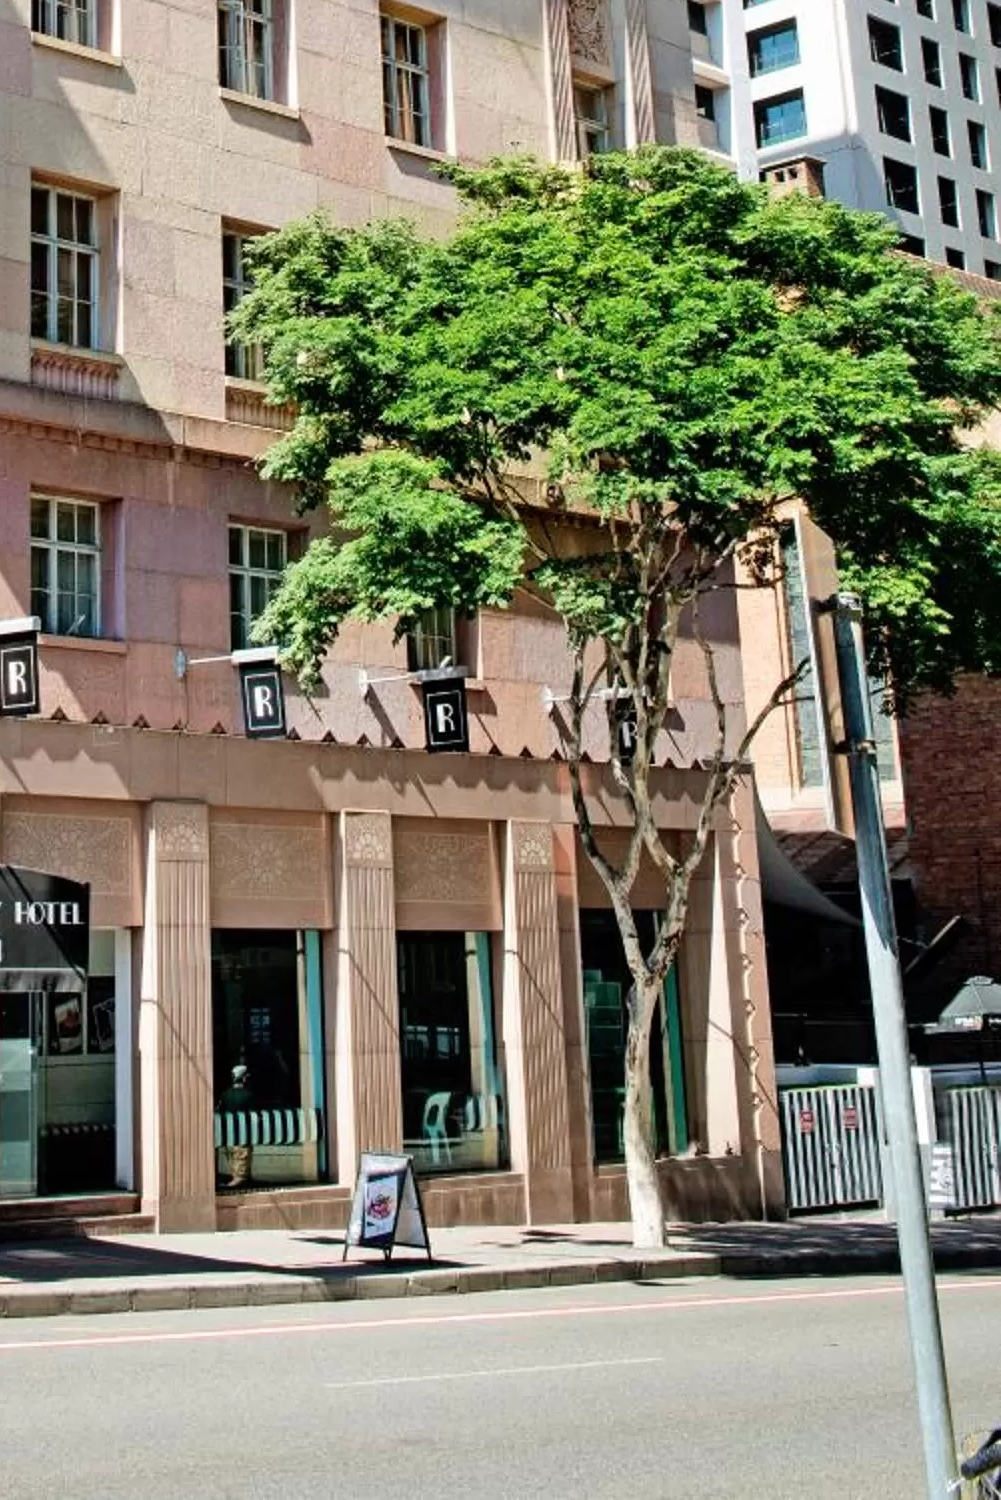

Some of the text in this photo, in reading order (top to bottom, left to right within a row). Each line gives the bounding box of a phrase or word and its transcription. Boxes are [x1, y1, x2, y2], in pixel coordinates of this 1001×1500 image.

[7, 660, 27, 695] R
[253, 685, 274, 718] R
[436, 703, 456, 733] R
[622, 721, 637, 749] R
[14, 901, 85, 925] HOTEL
